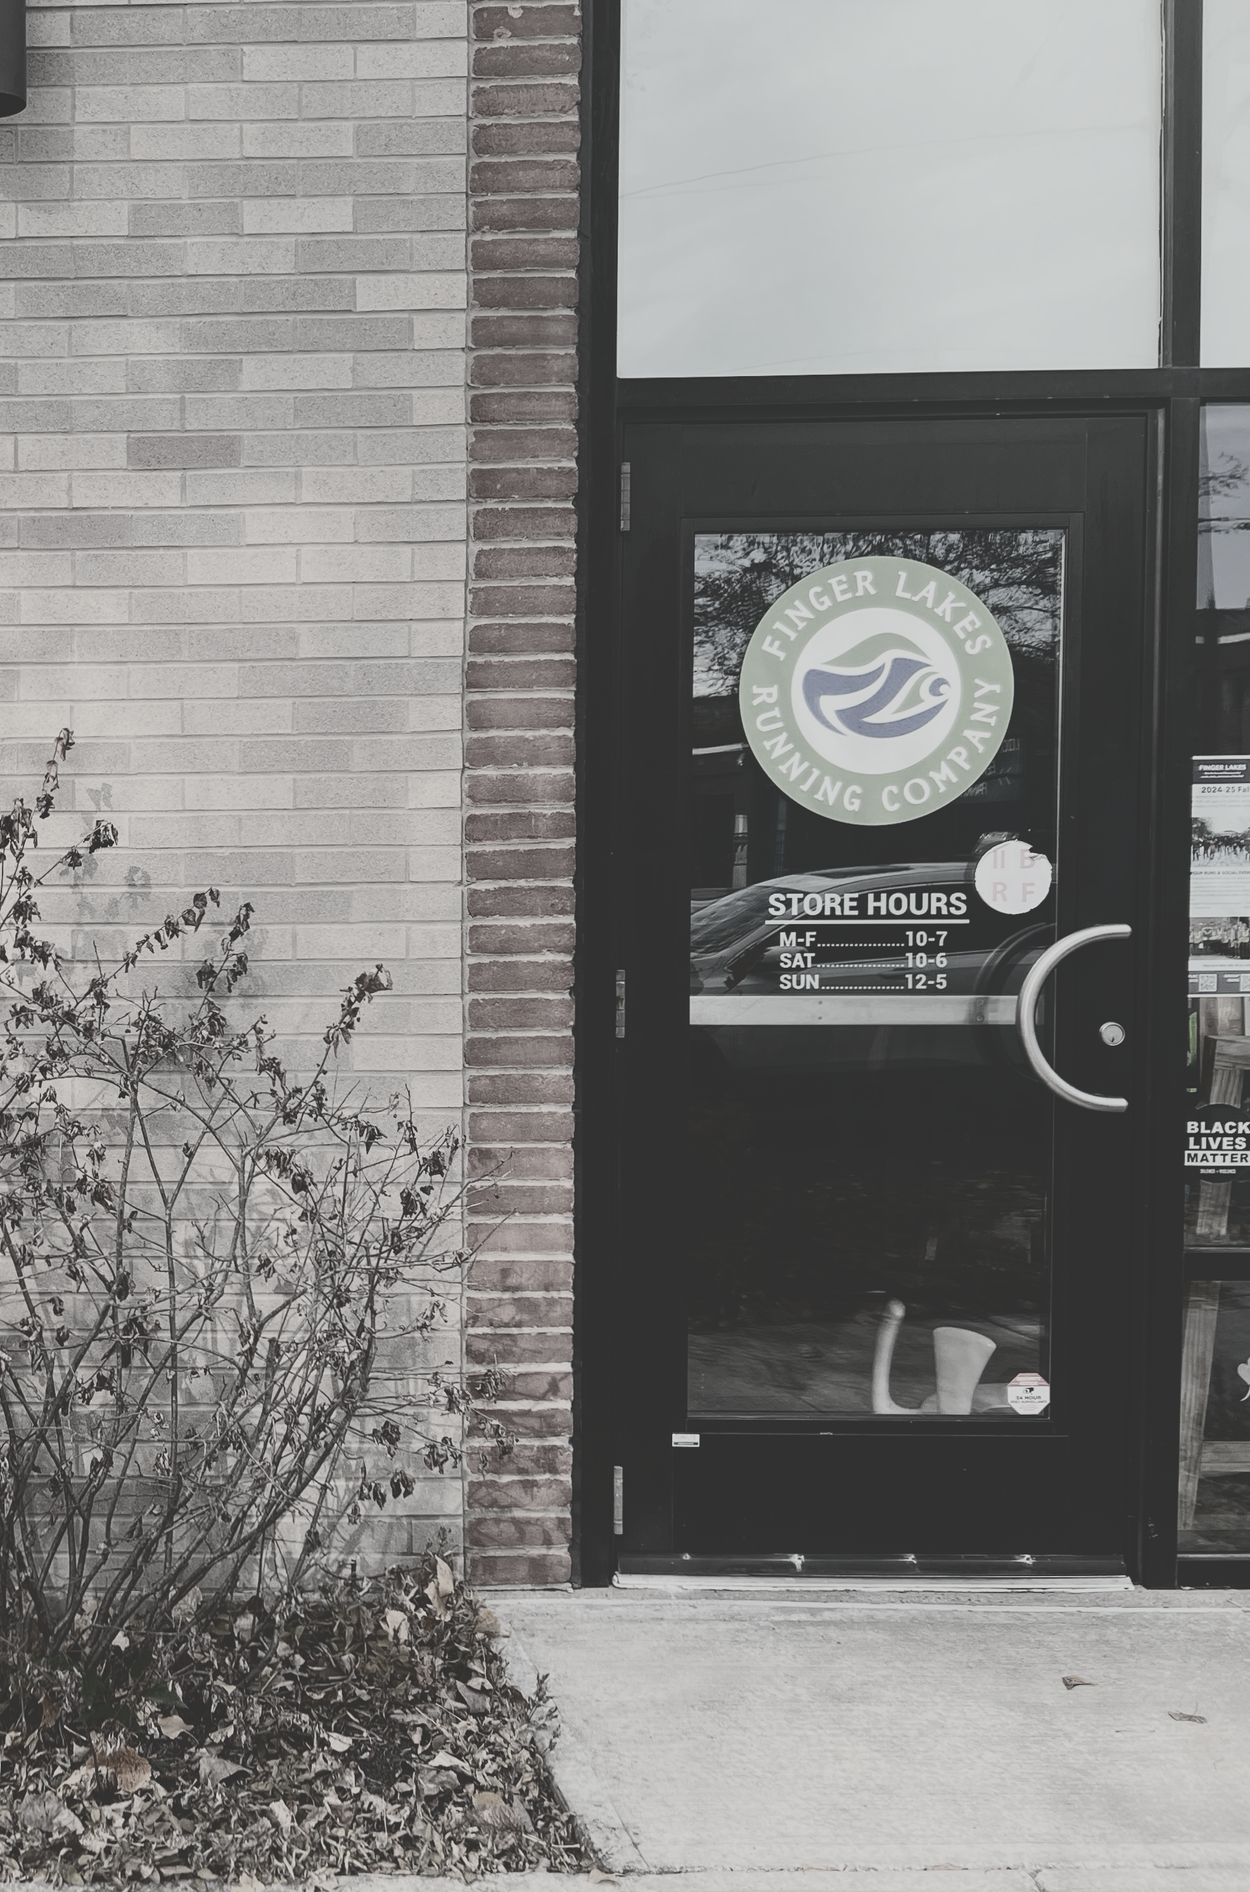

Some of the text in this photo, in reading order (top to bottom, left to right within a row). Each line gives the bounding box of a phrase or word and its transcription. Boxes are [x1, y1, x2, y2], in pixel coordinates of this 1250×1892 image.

[761, 569, 992, 661] FINGER LAKES
[751, 677, 1001, 812] RUNNING COMPANY
[767, 892, 968, 916] STORE HOURS
[779, 931, 948, 947] M-F 10-7
[779, 952, 948, 968] SAT 10-6
[779, 974, 947, 989] SUN 12-5
[1186, 1121, 1250, 1134] BLACK
[1188, 1136, 1247, 1150] LIVES
[1186, 1153, 1249, 1163] MATTER
